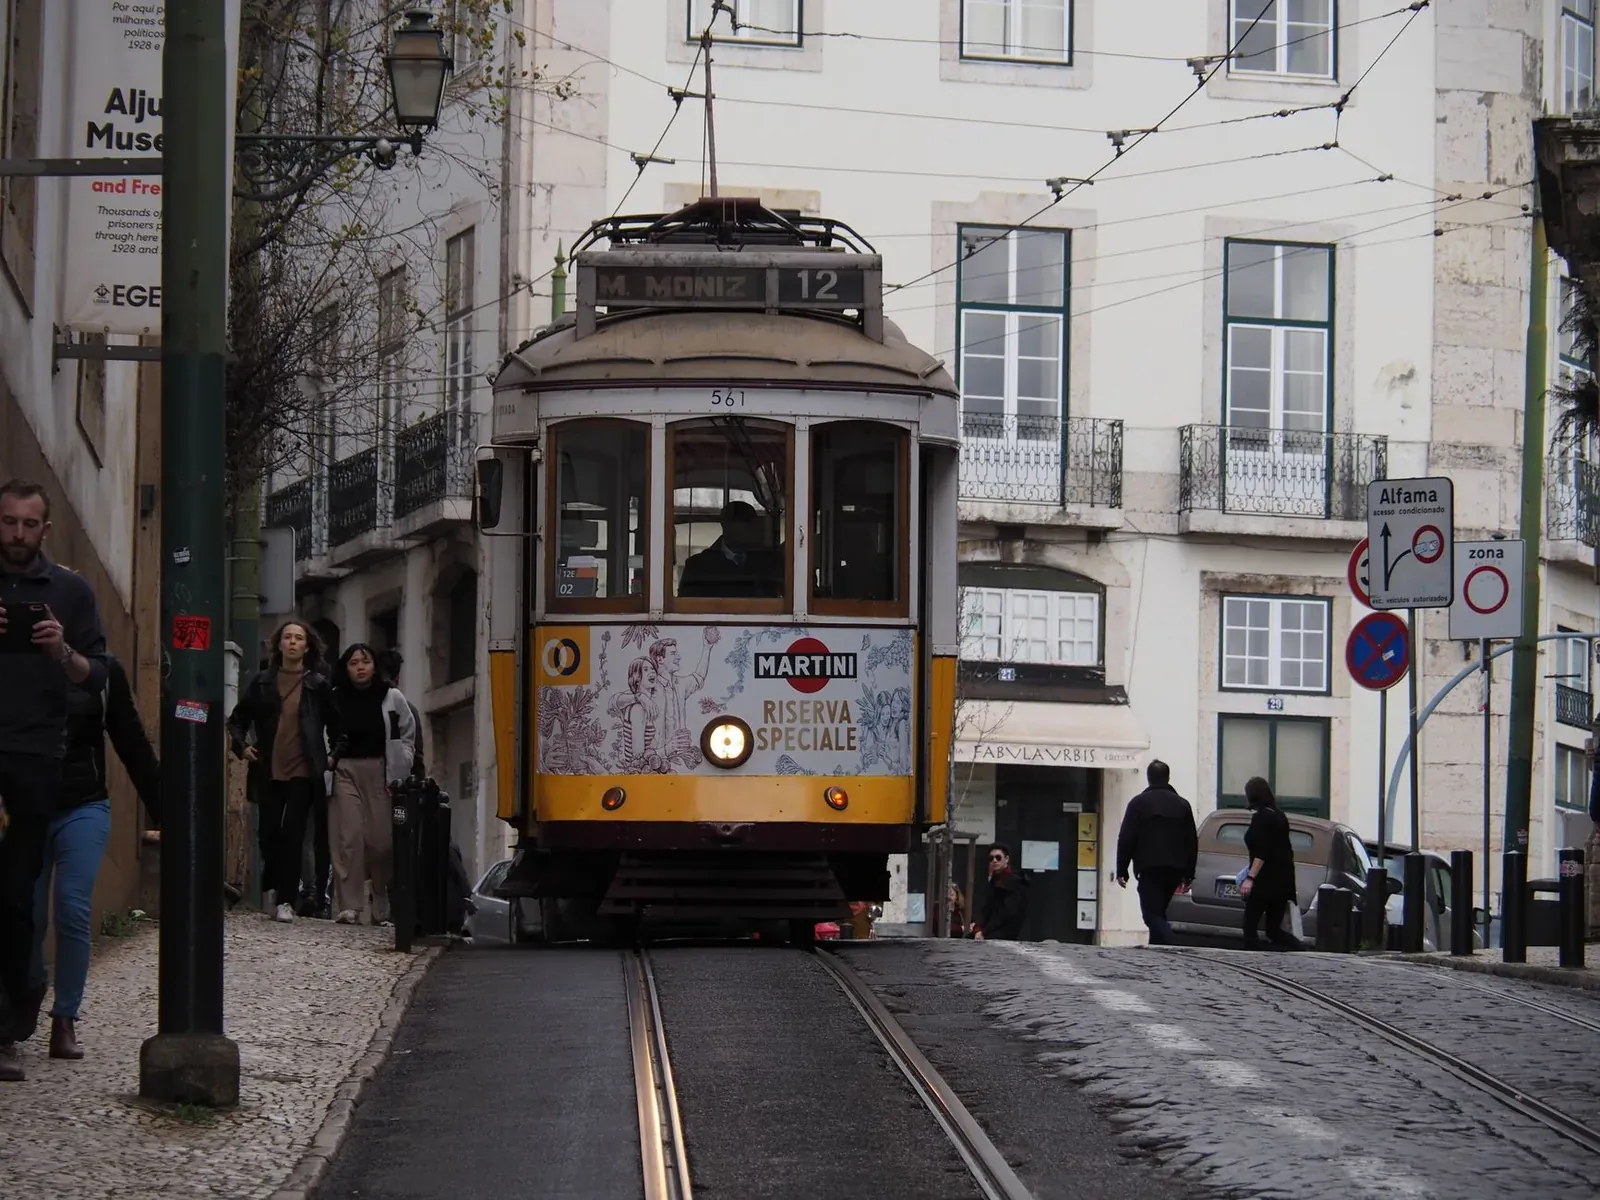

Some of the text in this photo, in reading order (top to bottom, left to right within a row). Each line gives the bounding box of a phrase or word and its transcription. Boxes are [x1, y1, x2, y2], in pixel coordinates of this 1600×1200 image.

[112, 2, 130, 11] Por
[132, 4, 155, 14] aqui
[112, 15, 156, 26] milhares
[128, 40, 152, 50] 1928
[104, 87, 164, 123] Alju
[86, 120, 164, 152] Muse
[92, 178, 161, 195] and Fre
[98, 205, 151, 217] Thousands
[108, 220, 153, 229] prisoners
[95, 231, 158, 243] through here
[112, 244, 159, 254] 1928 and
[598, 270, 838, 299] M. MONIZ 12
[113, 284, 161, 307] EGE
[711, 390, 744, 406] 561
[1380, 488, 1438, 504] Alfama
[1399, 507, 1445, 515] condicionado
[1469, 548, 1504, 559] zona
[560, 584, 573, 594] 02
[758, 656, 854, 676] MARTINI
[1270, 699, 1281, 709] 29
[763, 700, 851, 724] RISERVA
[757, 728, 856, 751] SPECIALE
[974, 745, 1096, 762] FABVLAVRBIS
